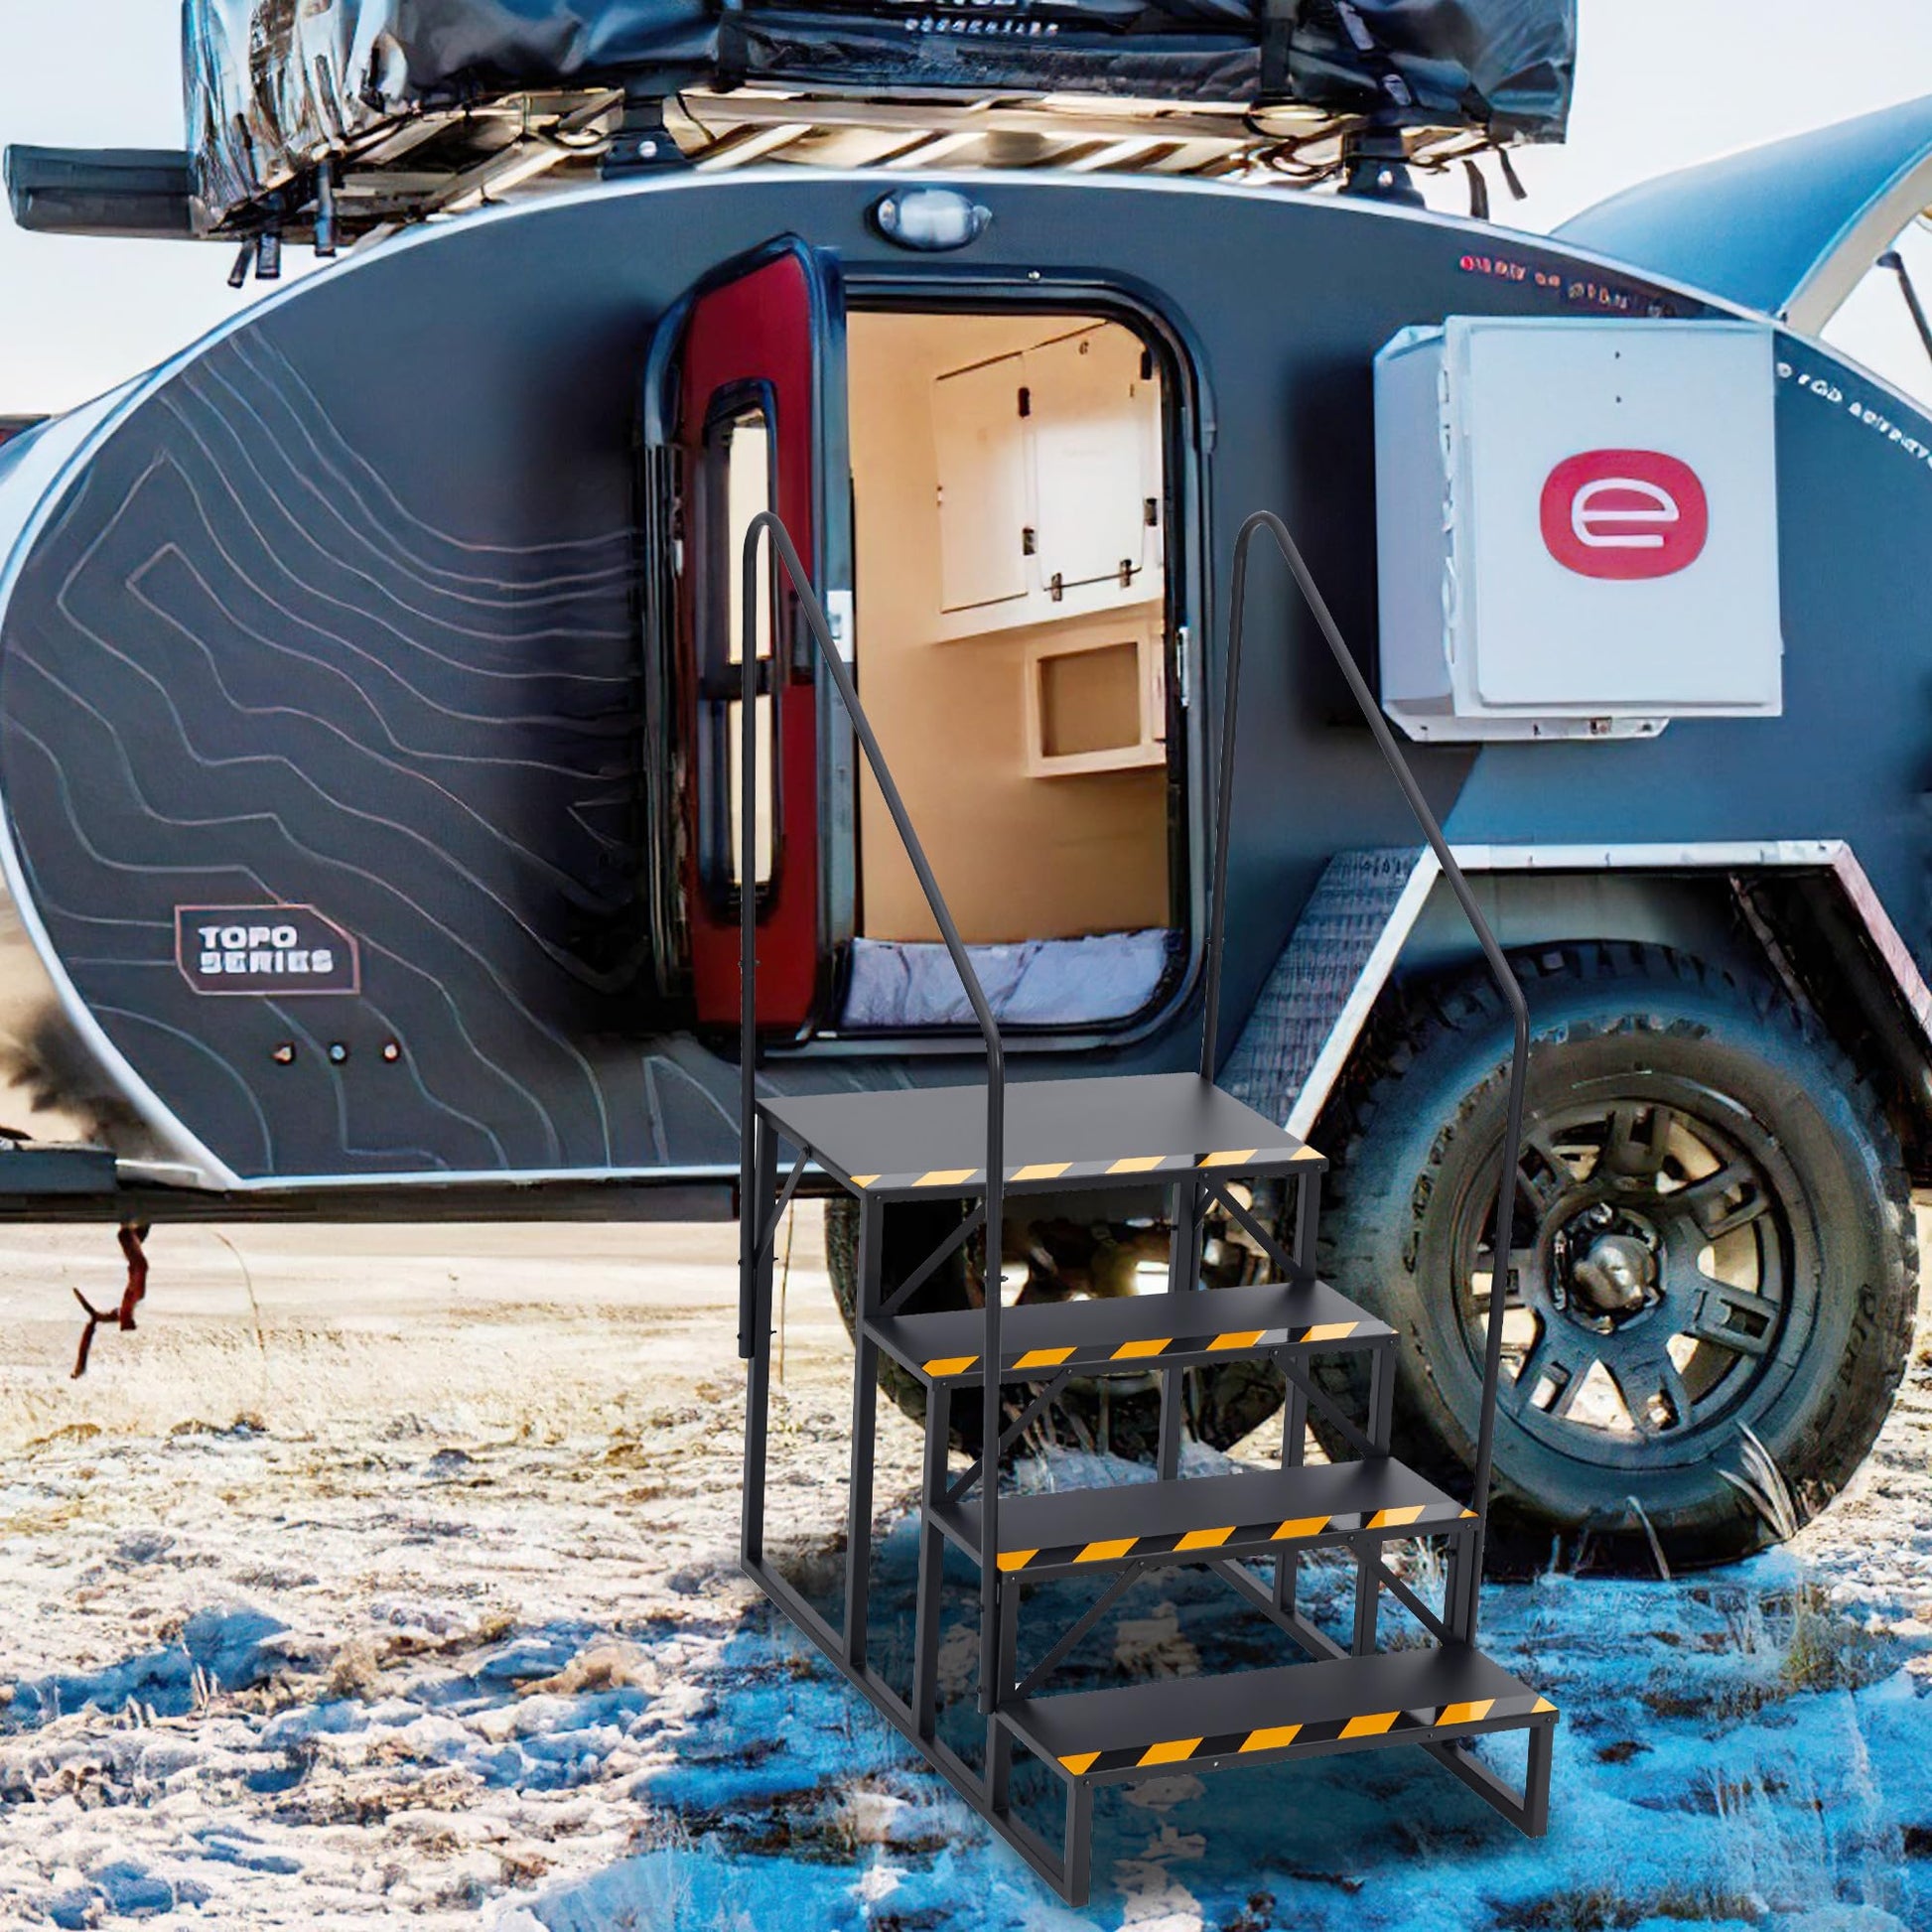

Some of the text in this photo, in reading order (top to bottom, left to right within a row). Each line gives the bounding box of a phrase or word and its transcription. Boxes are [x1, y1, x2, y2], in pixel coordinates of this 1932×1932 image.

[1571, 477, 1680, 548] e
[198, 925, 298, 949] TOPO
[199, 949, 334, 974] SERIES
